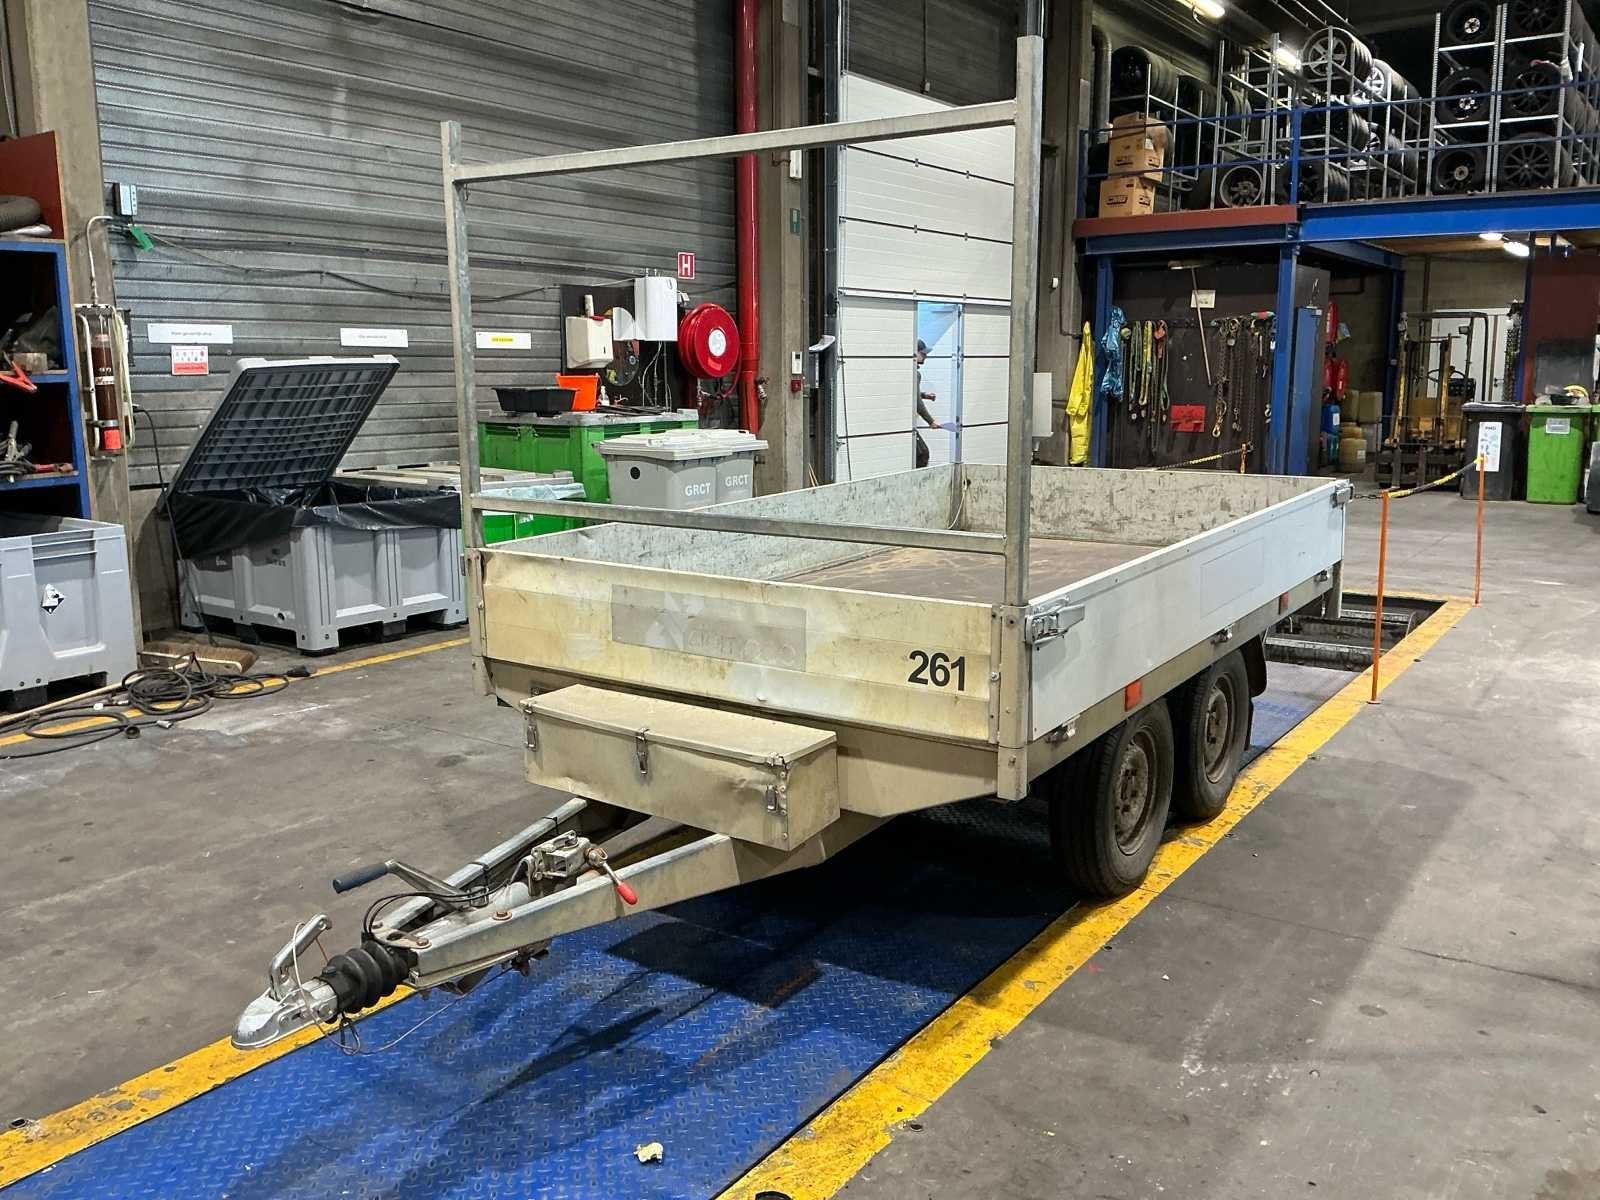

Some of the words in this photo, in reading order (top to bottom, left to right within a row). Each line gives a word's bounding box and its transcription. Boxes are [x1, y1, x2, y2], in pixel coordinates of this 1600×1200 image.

[682, 255, 691, 276] H
[684, 482, 711, 497] GRCT
[725, 474, 749, 487] GRCT
[908, 650, 965, 692] 261
